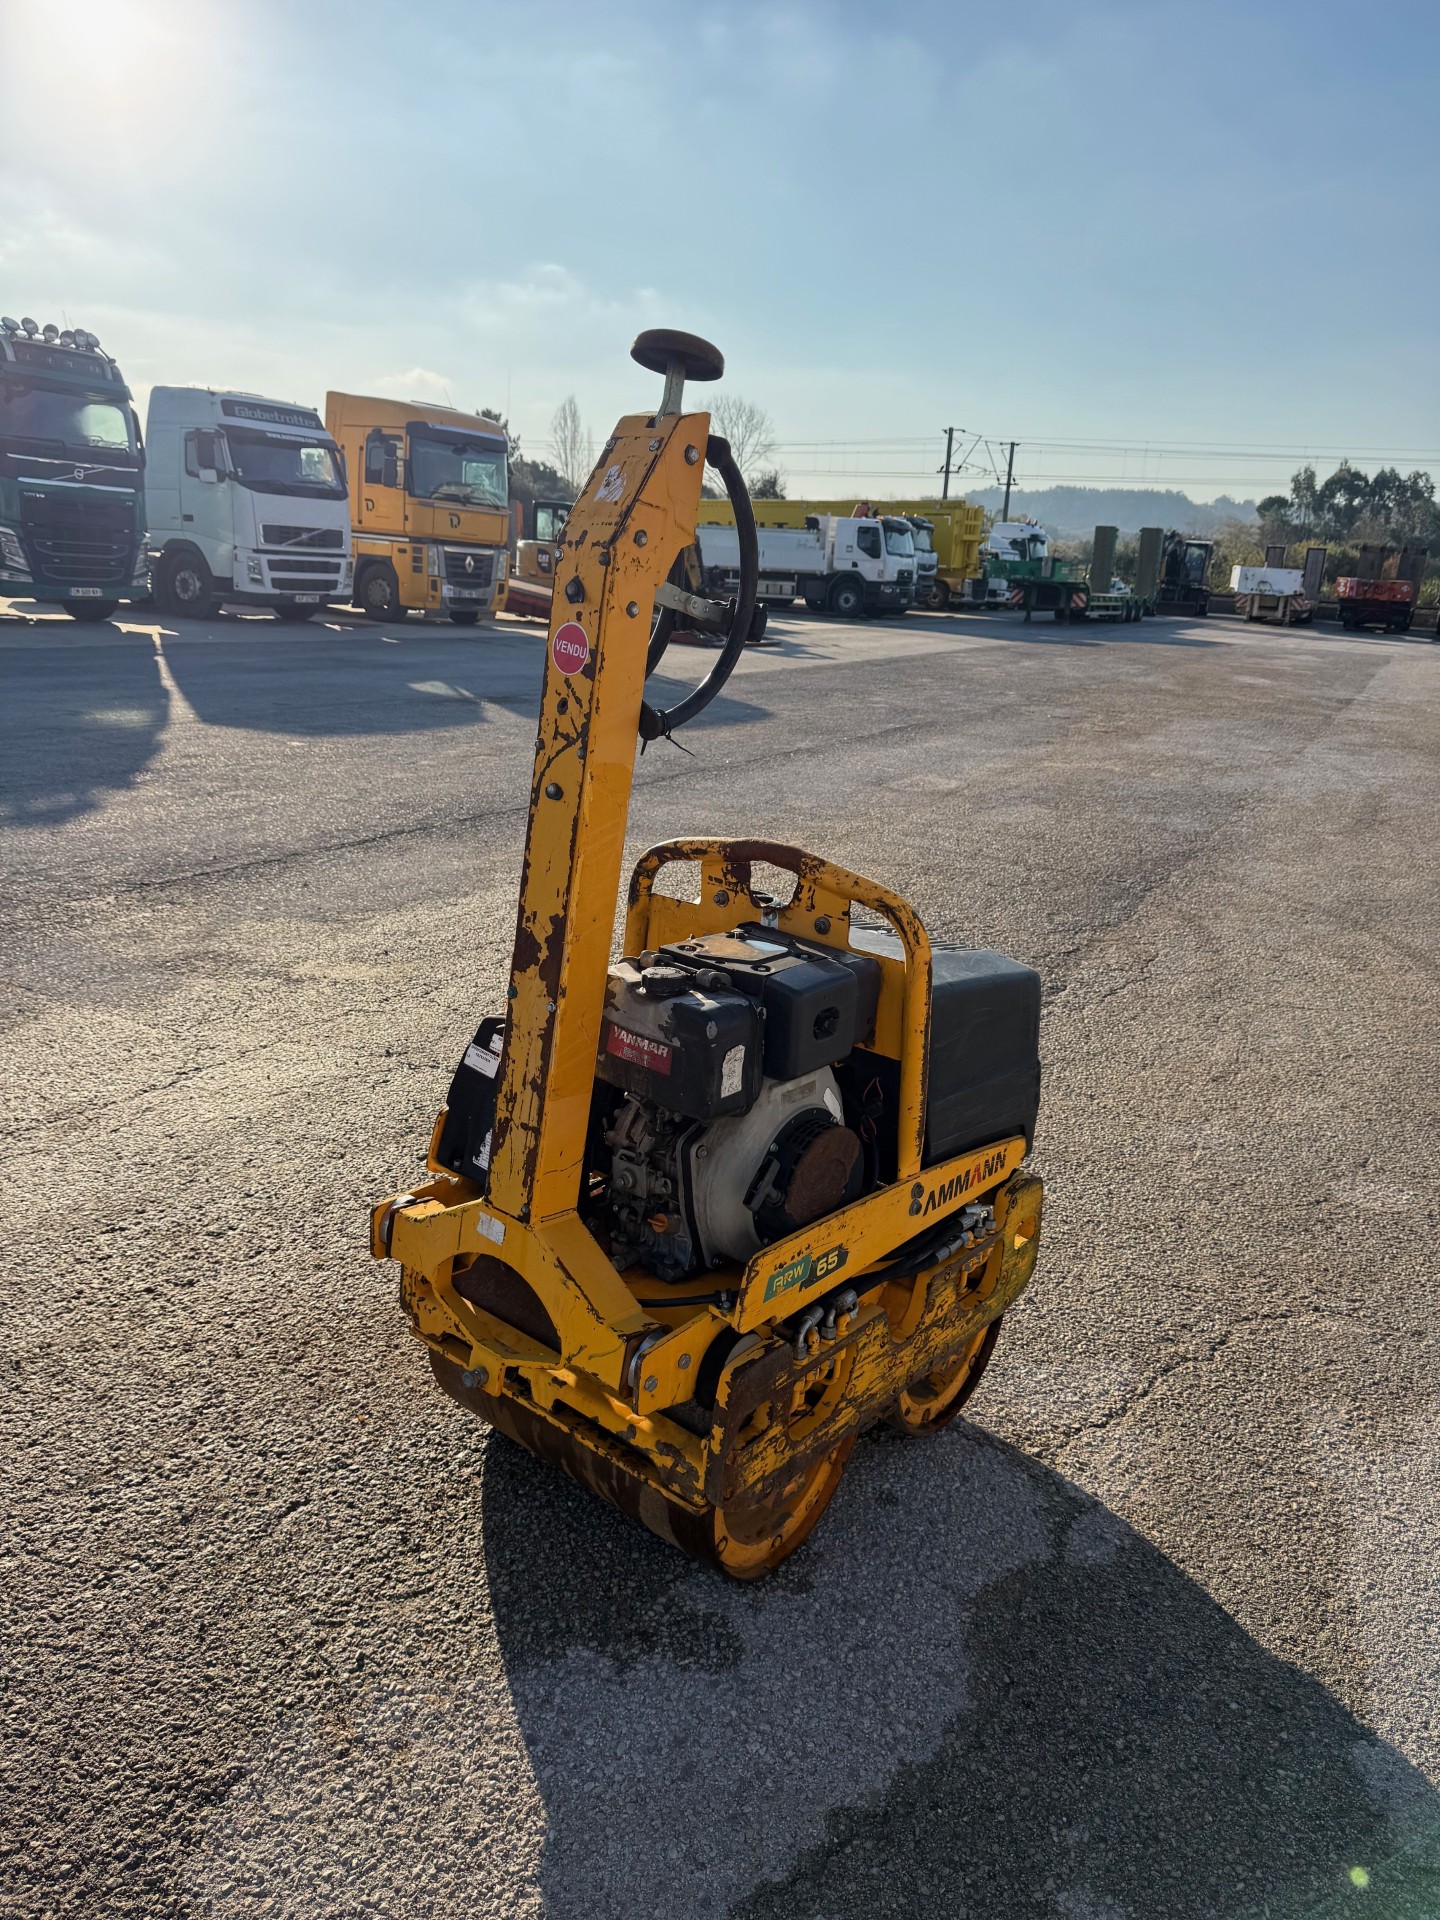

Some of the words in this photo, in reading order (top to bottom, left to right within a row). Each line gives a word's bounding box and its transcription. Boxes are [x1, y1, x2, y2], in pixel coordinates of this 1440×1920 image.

[234, 406, 317, 428] Globetrotter
[538, 553, 550, 563] CAT
[556, 638, 587, 659] VENDU
[614, 1026, 669, 1058] YANMAR
[923, 1148, 1008, 1216] AMMANN
[773, 1260, 806, 1293] ARW
[816, 1250, 839, 1277] 65
